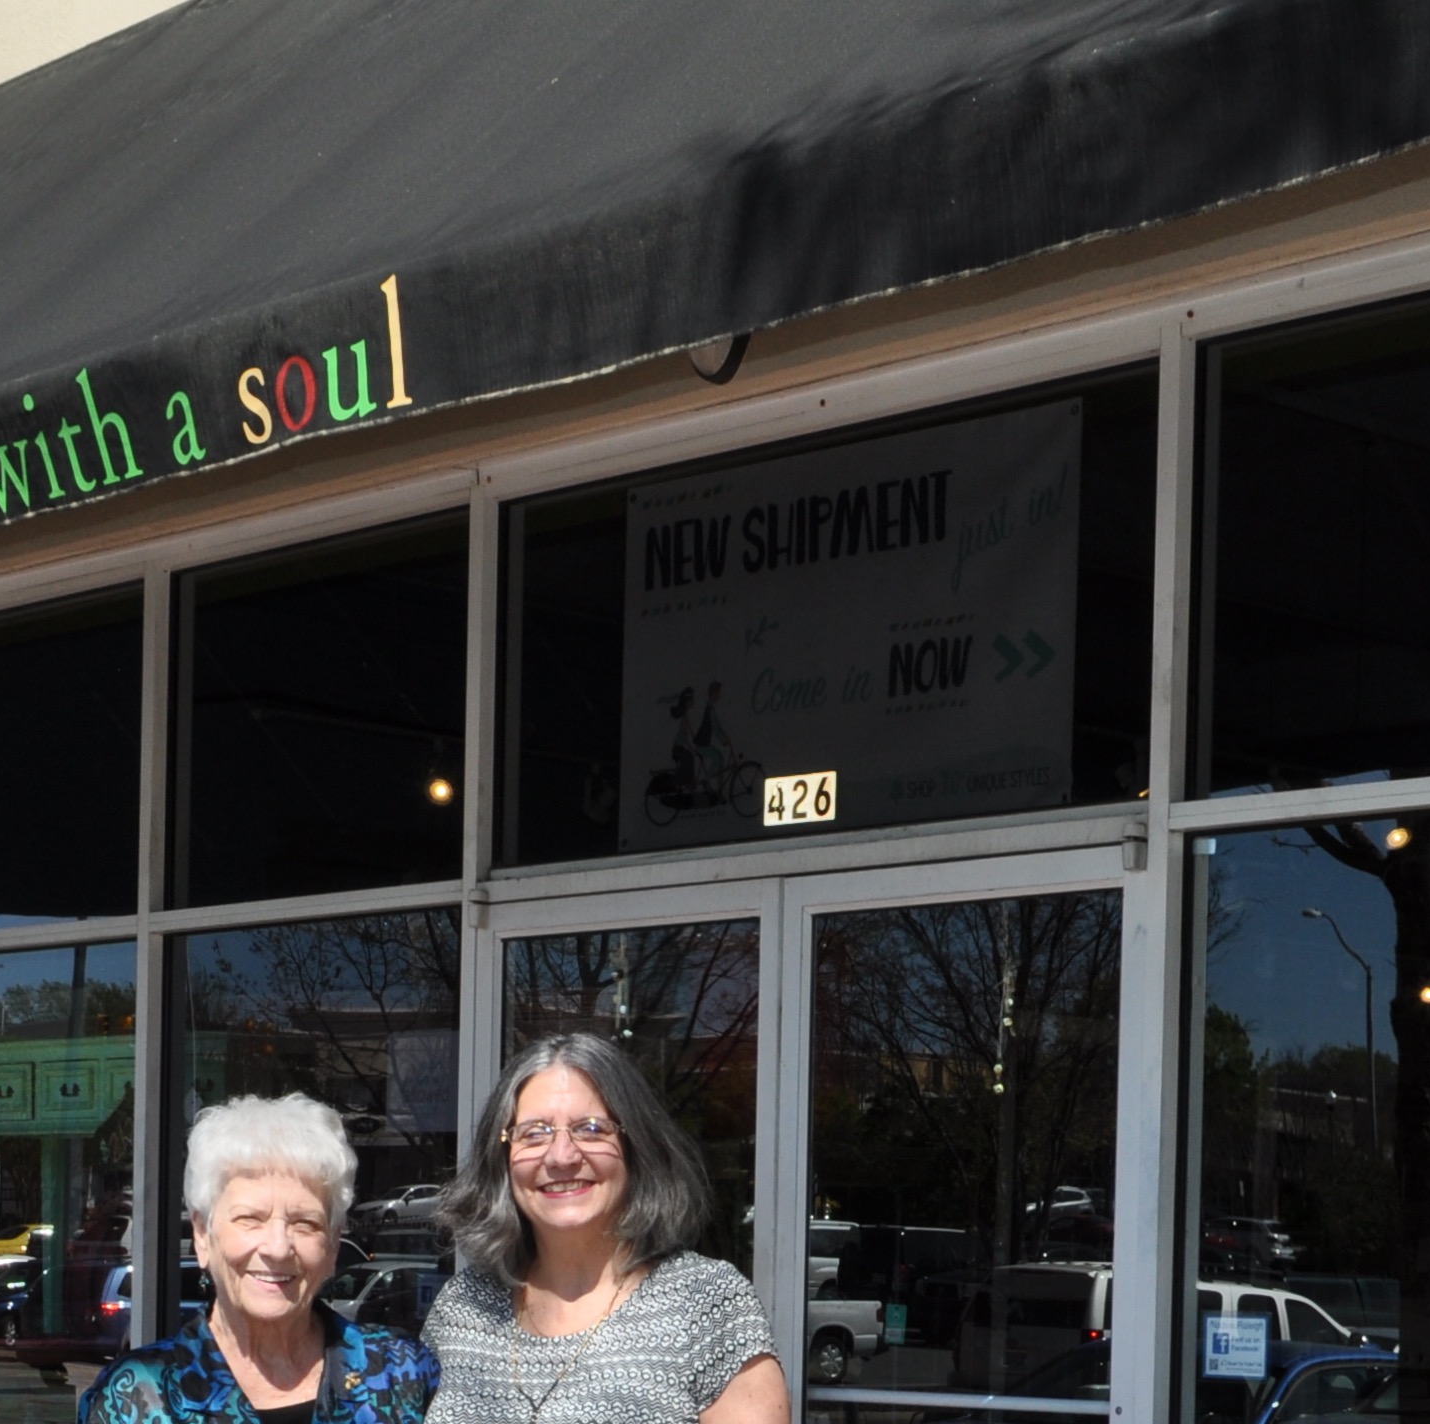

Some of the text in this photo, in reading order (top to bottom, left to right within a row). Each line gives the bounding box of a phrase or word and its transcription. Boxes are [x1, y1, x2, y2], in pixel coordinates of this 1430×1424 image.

[165, 389, 207, 465] a
[237, 273, 414, 446] soul
[643, 516, 732, 592] NEW
[741, 469, 954, 575] SHIPMENT
[950, 496, 1014, 594] just
[750, 635, 973, 716] Come in NOW
[767, 776, 832, 822] 426
